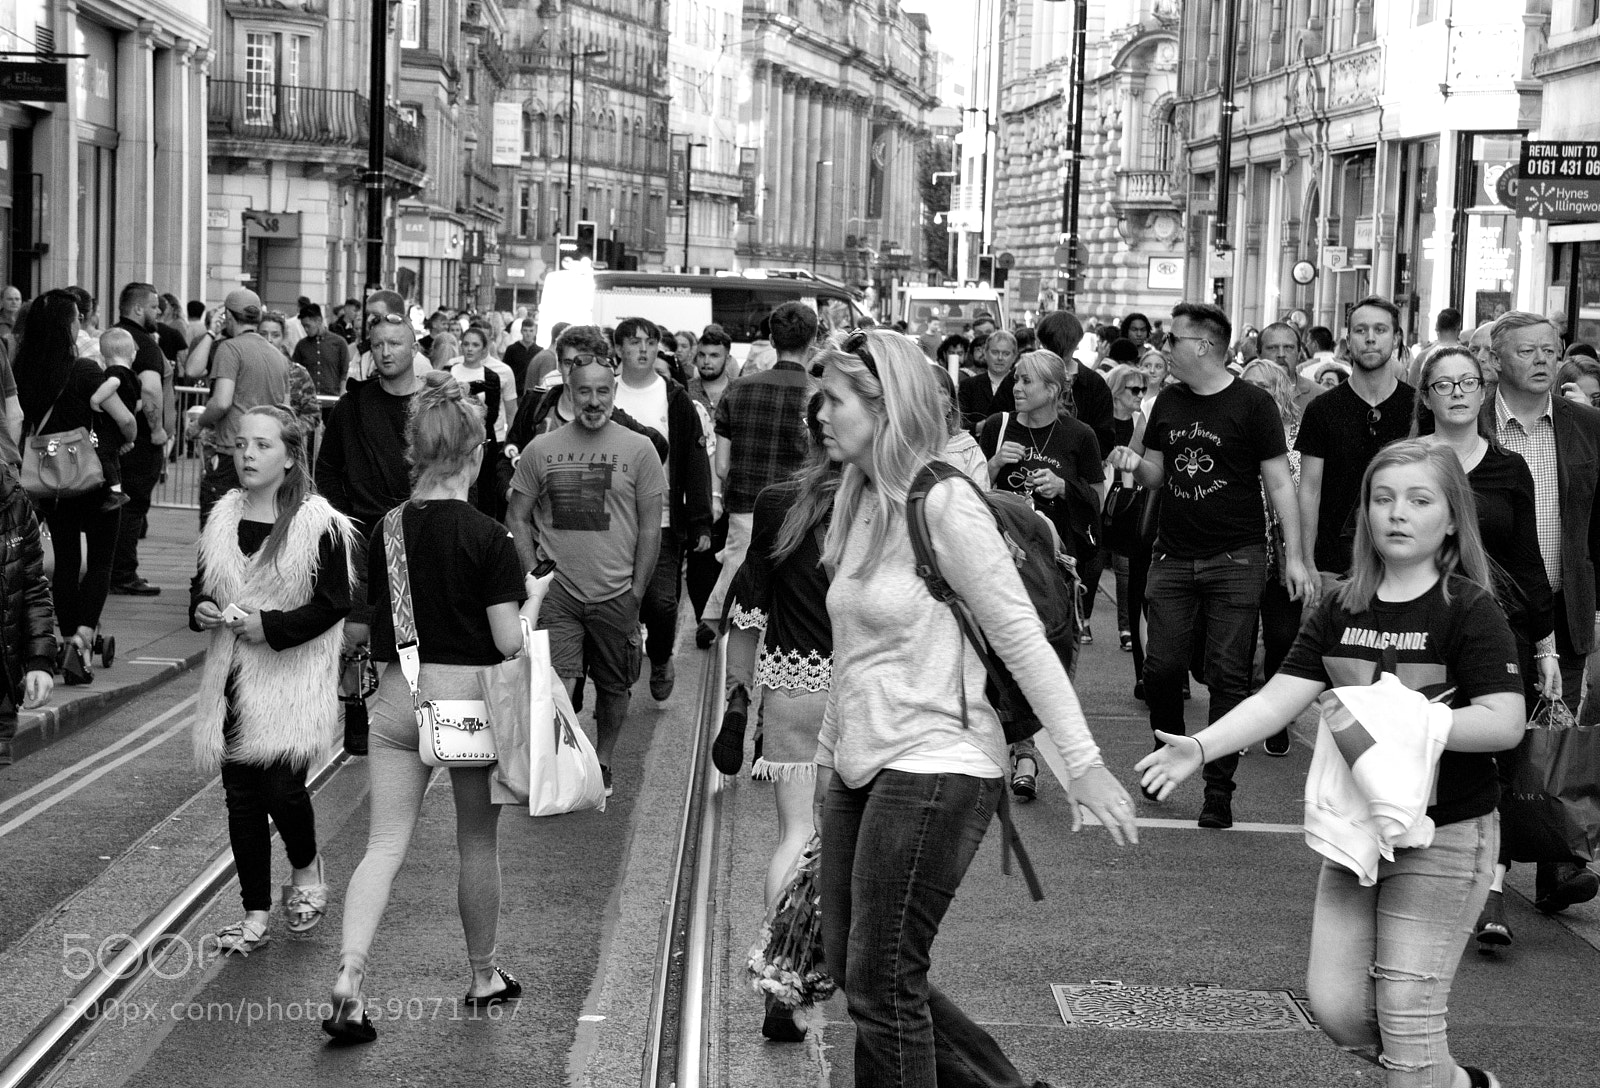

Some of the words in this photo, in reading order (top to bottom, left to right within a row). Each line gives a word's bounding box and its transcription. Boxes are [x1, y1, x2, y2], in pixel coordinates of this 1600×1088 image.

[1529, 144, 1559, 157] RETAIL
[1562, 145, 1583, 158] UNIT
[1586, 145, 1598, 158] TO
[1527, 159, 1556, 175] 0161
[1559, 160, 1582, 176] 431
[1556, 187, 1589, 201] Hynes
[659, 286, 691, 294] POLICE
[1168, 429, 1187, 445] Bee
[1188, 421, 1223, 447] Forever
[1174, 484, 1191, 499] Our
[1194, 479, 1228, 501] Hearts
[1512, 792, 1545, 801] ARA
